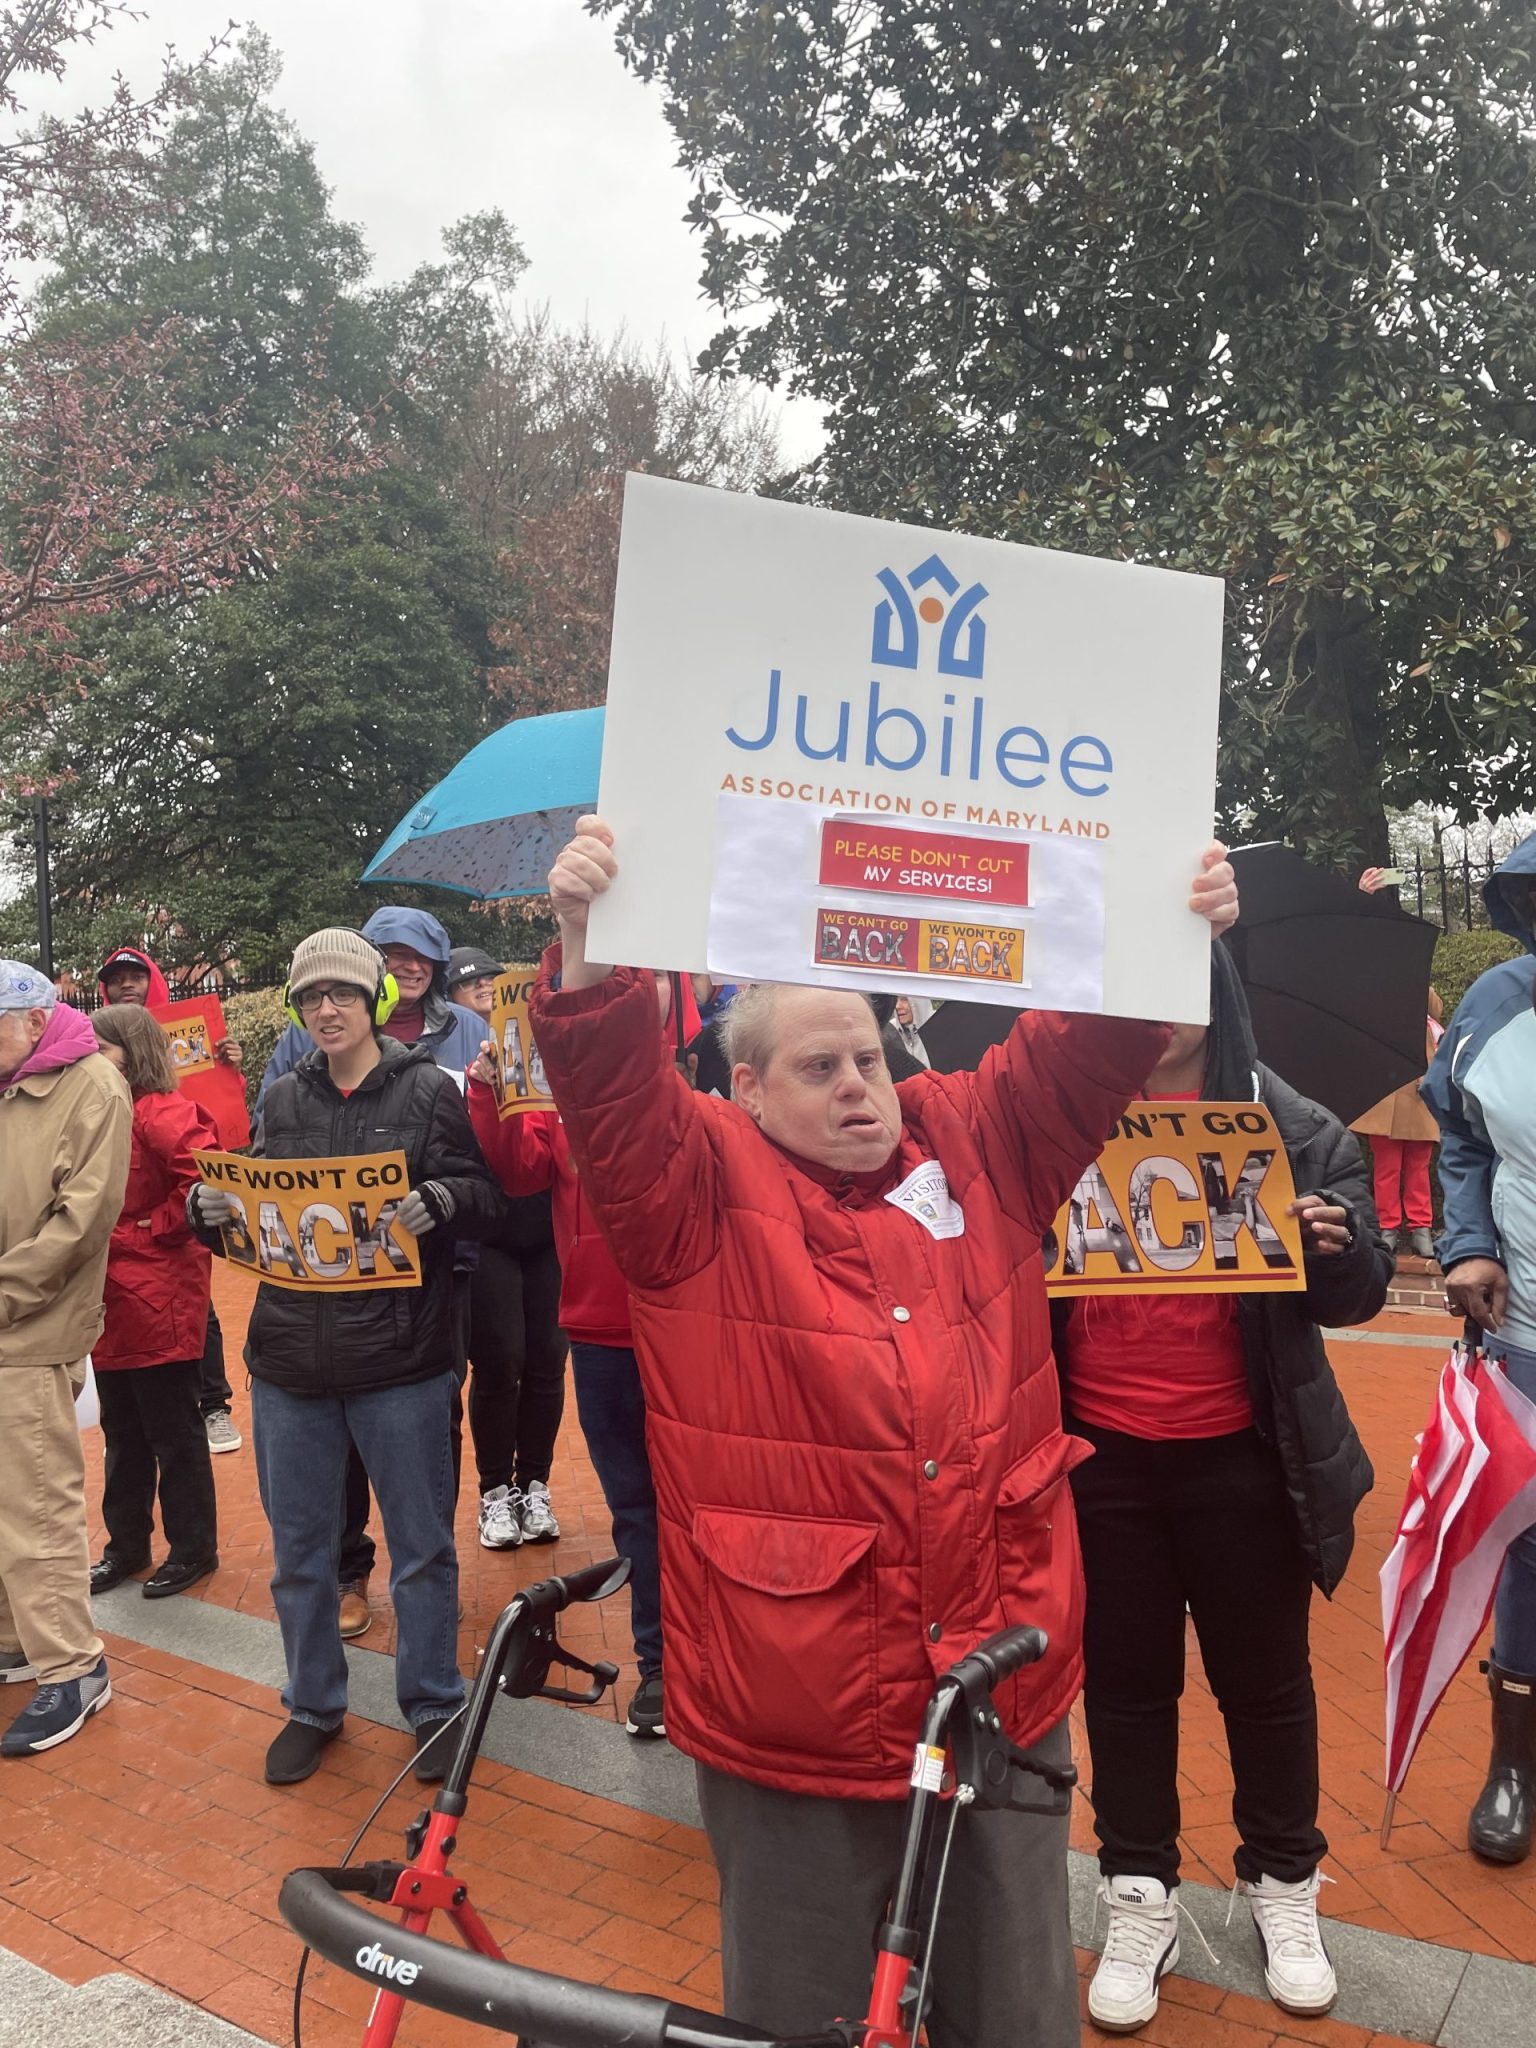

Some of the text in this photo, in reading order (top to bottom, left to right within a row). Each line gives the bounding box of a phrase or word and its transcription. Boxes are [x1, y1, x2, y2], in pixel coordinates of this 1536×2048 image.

[725, 669, 1113, 797] Jubilee
[720, 774, 1111, 839] ASSOCIATION OF MARYLAND
[835, 840, 1014, 873] PLEASE DON'T CUT
[863, 865, 992, 893] MY SERVICES!
[823, 913, 909, 932] WE CAN'T GO
[928, 923, 1016, 942] WE WON'T GO
[821, 925, 906, 965] BACK
[929, 935, 1013, 976] BACK
[190, 1024, 205, 1034] GO
[171, 1034, 211, 1066] CK
[1202, 1111, 1268, 1135] GO
[198, 1159, 242, 1183] WE
[356, 1163, 403, 1188] GO
[1041, 1149, 1297, 1275] ACK
[222, 1196, 416, 1278] BACK
[356, 1942, 418, 1986] drive
